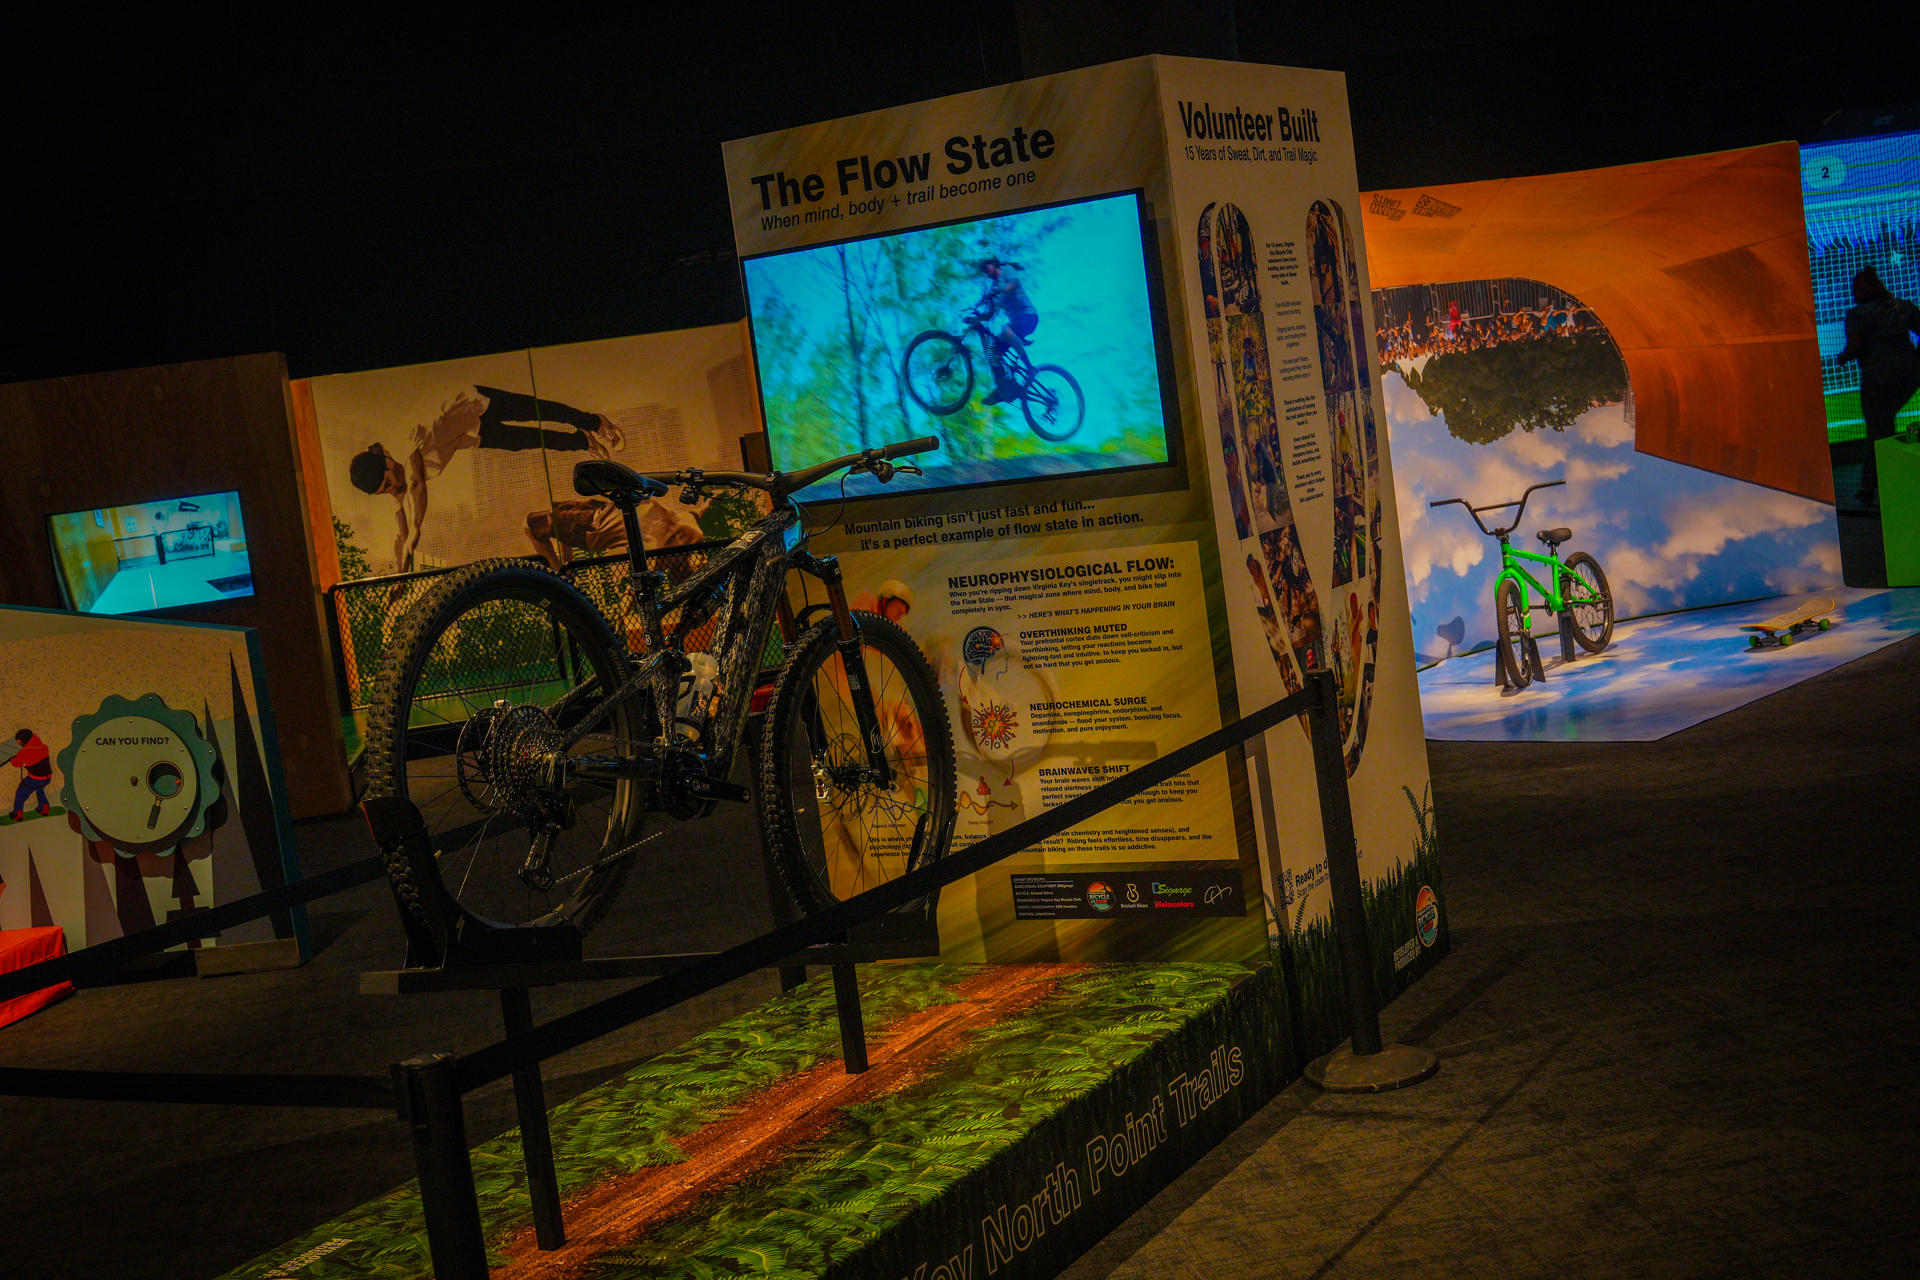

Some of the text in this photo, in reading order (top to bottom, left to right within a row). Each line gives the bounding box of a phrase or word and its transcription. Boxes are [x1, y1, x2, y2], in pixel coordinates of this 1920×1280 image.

[1178, 100, 1320, 142] Volunteer Built
[1185, 145, 1318, 165] 15 Years of Sweat, Dirt, and Trail Magic
[751, 127, 1056, 210] The Flow State
[1821, 166, 1830, 178] 2
[761, 212, 800, 231] When
[805, 204, 844, 223] mind,
[849, 197, 885, 216] body
[907, 186, 935, 205] trail
[939, 177, 1001, 200] become
[1006, 169, 1036, 187] one
[844, 499, 1095, 536] Mountain biking isn't just fast and fun...
[861, 512, 1144, 551] it's a perfect example of flow state in action.
[948, 557, 1175, 589] NEUROPHYSIOLOGICAL FLOW:
[968, 588, 988, 597] you're
[990, 587, 1012, 595] ripping
[1032, 582, 1057, 590] Virginia
[1059, 580, 1077, 588] Key's
[1079, 577, 1117, 587] singletrack,
[1133, 573, 1152, 581] might
[1154, 572, 1166, 580] slip
[1018, 592, 1043, 600] magical
[952, 606, 985, 615] completely
[996, 604, 1012, 612] sync.
[1029, 610, 1053, 619] HERE'S
[1054, 608, 1079, 617] WHAT'S
[1081, 604, 1121, 615] HAPPENING
[1132, 602, 1151, 610] YOUR
[1153, 600, 1175, 608] BRAIN
[1019, 623, 1128, 639] OVERTHINKING MUTED
[1121, 630, 1160, 638] self-criticism
[1021, 645, 1061, 654] overthinking,
[1022, 653, 1061, 662] lightning-fast
[1111, 648, 1126, 656] keep
[1030, 696, 1147, 711] NEUROCHEMICAL SURGE
[1134, 713, 1161, 721] boosting
[1033, 727, 1066, 735] motivation,
[1095, 723, 1128, 732] enjoyment.
[96, 736, 169, 746] CAN YOU FIND?
[1039, 764, 1130, 777] BRAINWAVES SHIFT
[1115, 827, 1148, 835] heightened
[981, 1161, 1082, 1276] North
[1086, 1095, 1168, 1196] Point
[1169, 1045, 1244, 1129] Trails
